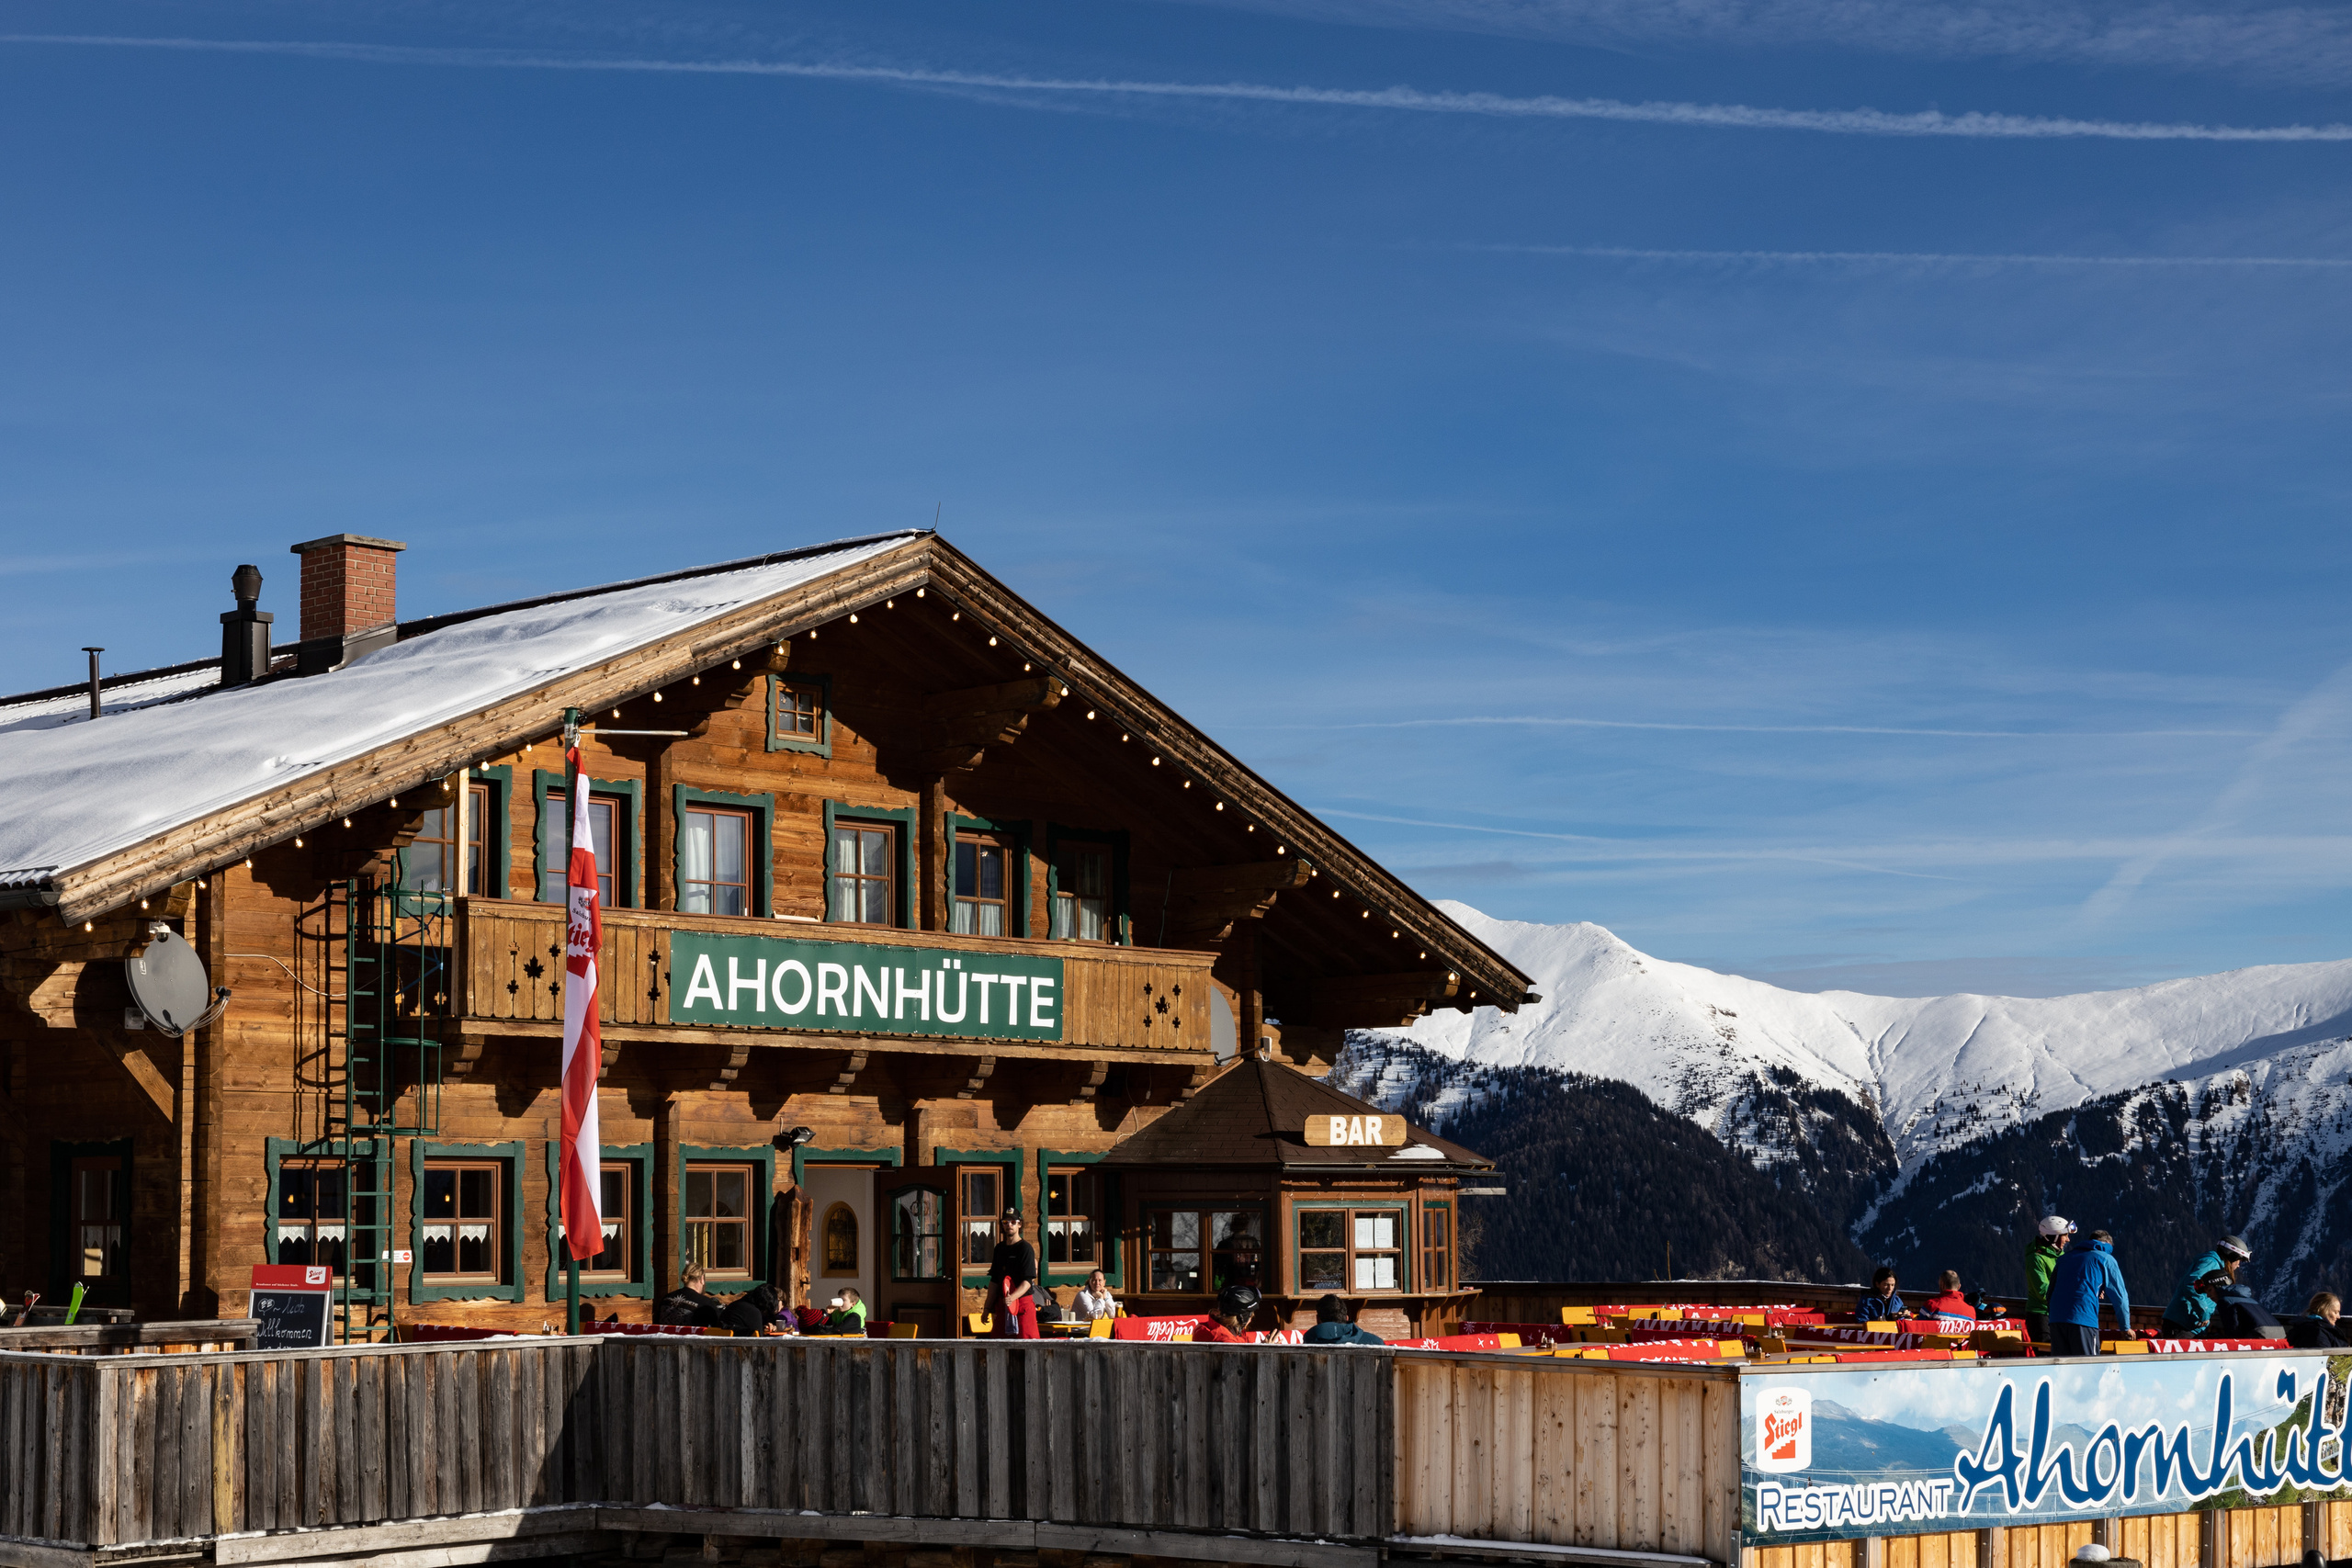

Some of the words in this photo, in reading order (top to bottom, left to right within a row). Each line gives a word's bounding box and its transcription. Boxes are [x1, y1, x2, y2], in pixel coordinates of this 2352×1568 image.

[683, 953, 1055, 1028] AHORNHÜTTE
[1329, 1116, 1384, 1145] BAR
[1764, 1411, 1803, 1451] Stiegl
